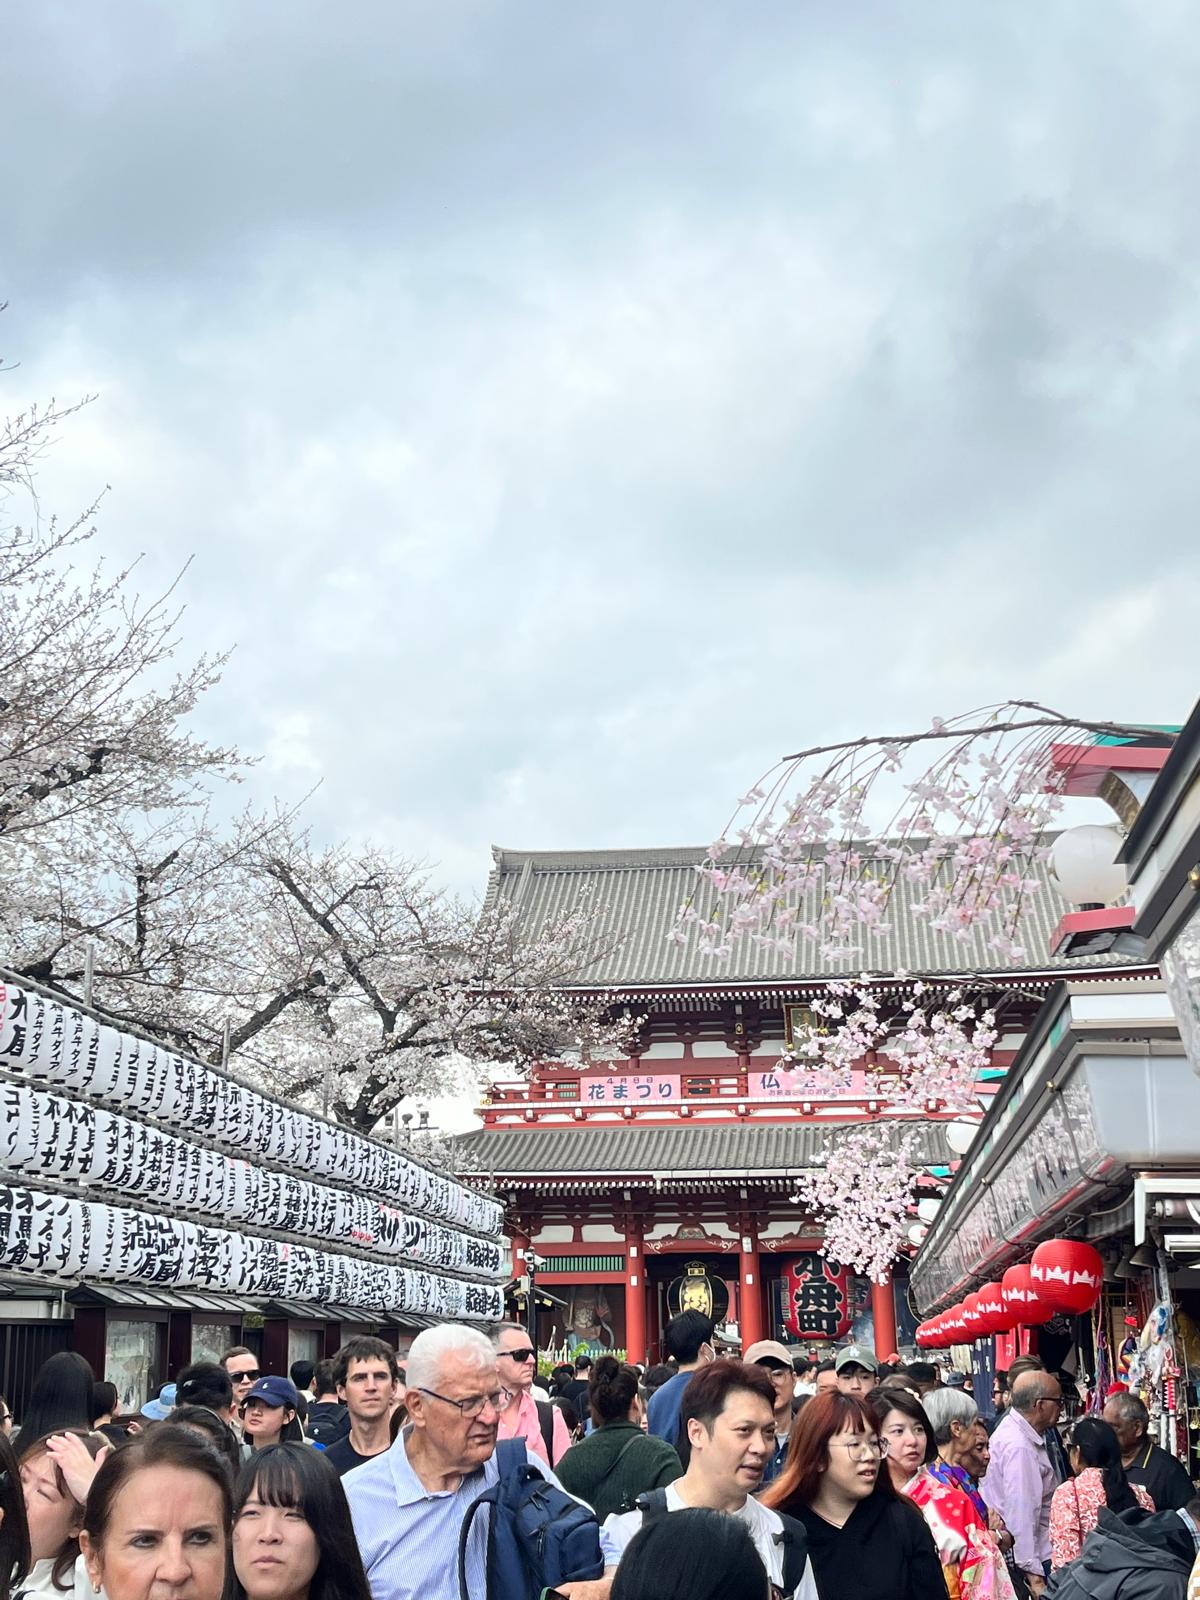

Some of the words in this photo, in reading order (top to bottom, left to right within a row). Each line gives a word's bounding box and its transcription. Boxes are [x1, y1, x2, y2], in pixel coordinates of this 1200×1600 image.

[588, 1083, 672, 1100] 花まつり
[792, 1257, 844, 1336] 小舟町
